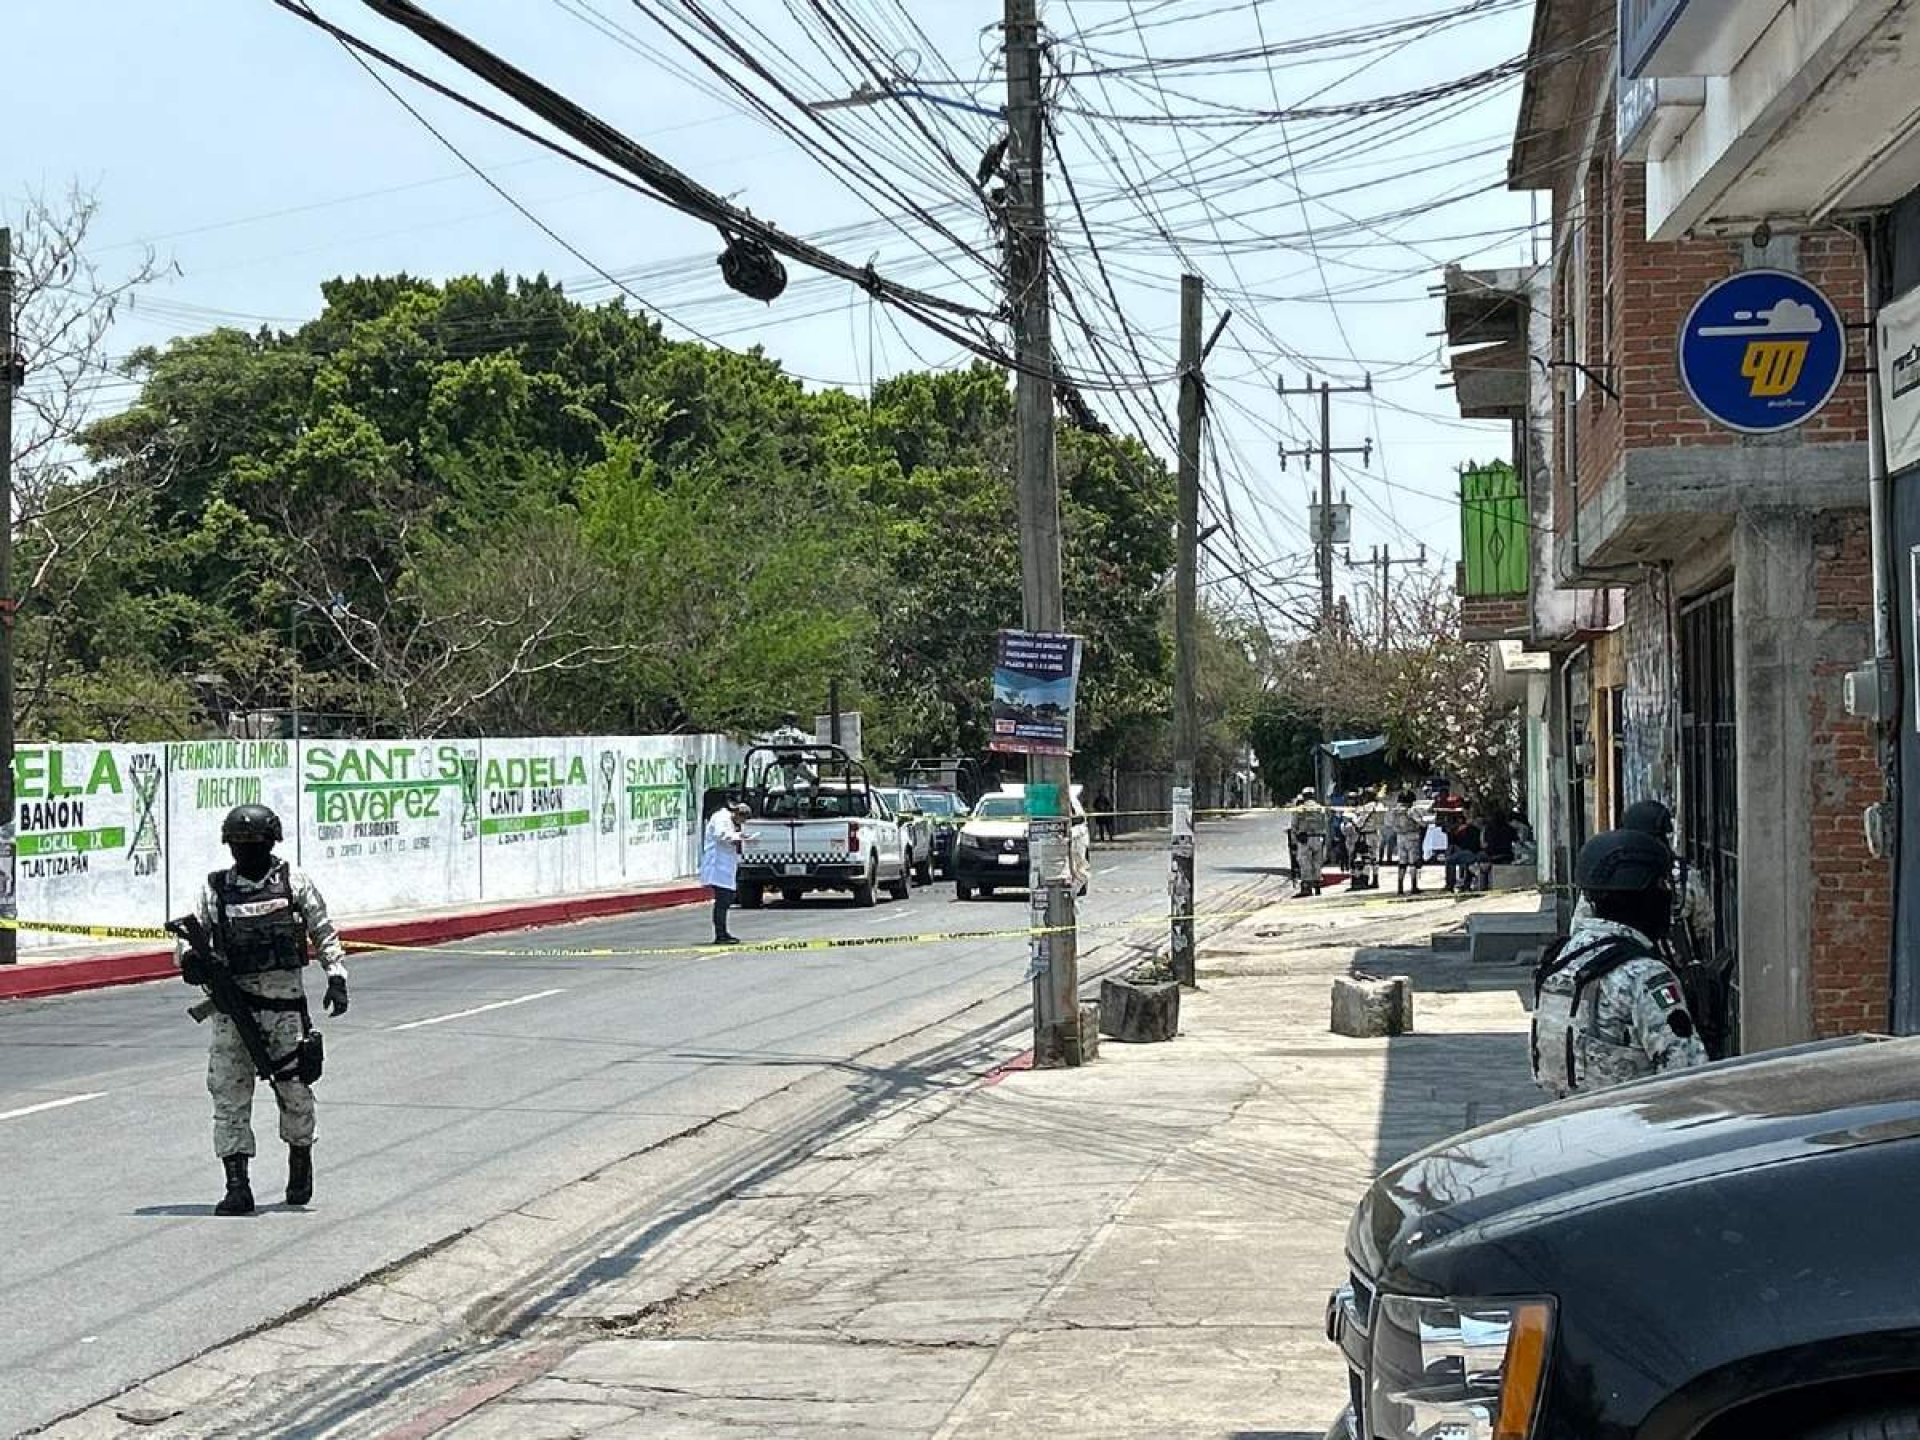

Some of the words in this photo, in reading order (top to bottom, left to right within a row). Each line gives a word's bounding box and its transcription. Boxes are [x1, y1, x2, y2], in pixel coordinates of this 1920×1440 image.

[169, 743, 223, 771] PERMISO
[484, 756, 588, 789] ADELA
[196, 776, 261, 808] DIRECTIVA
